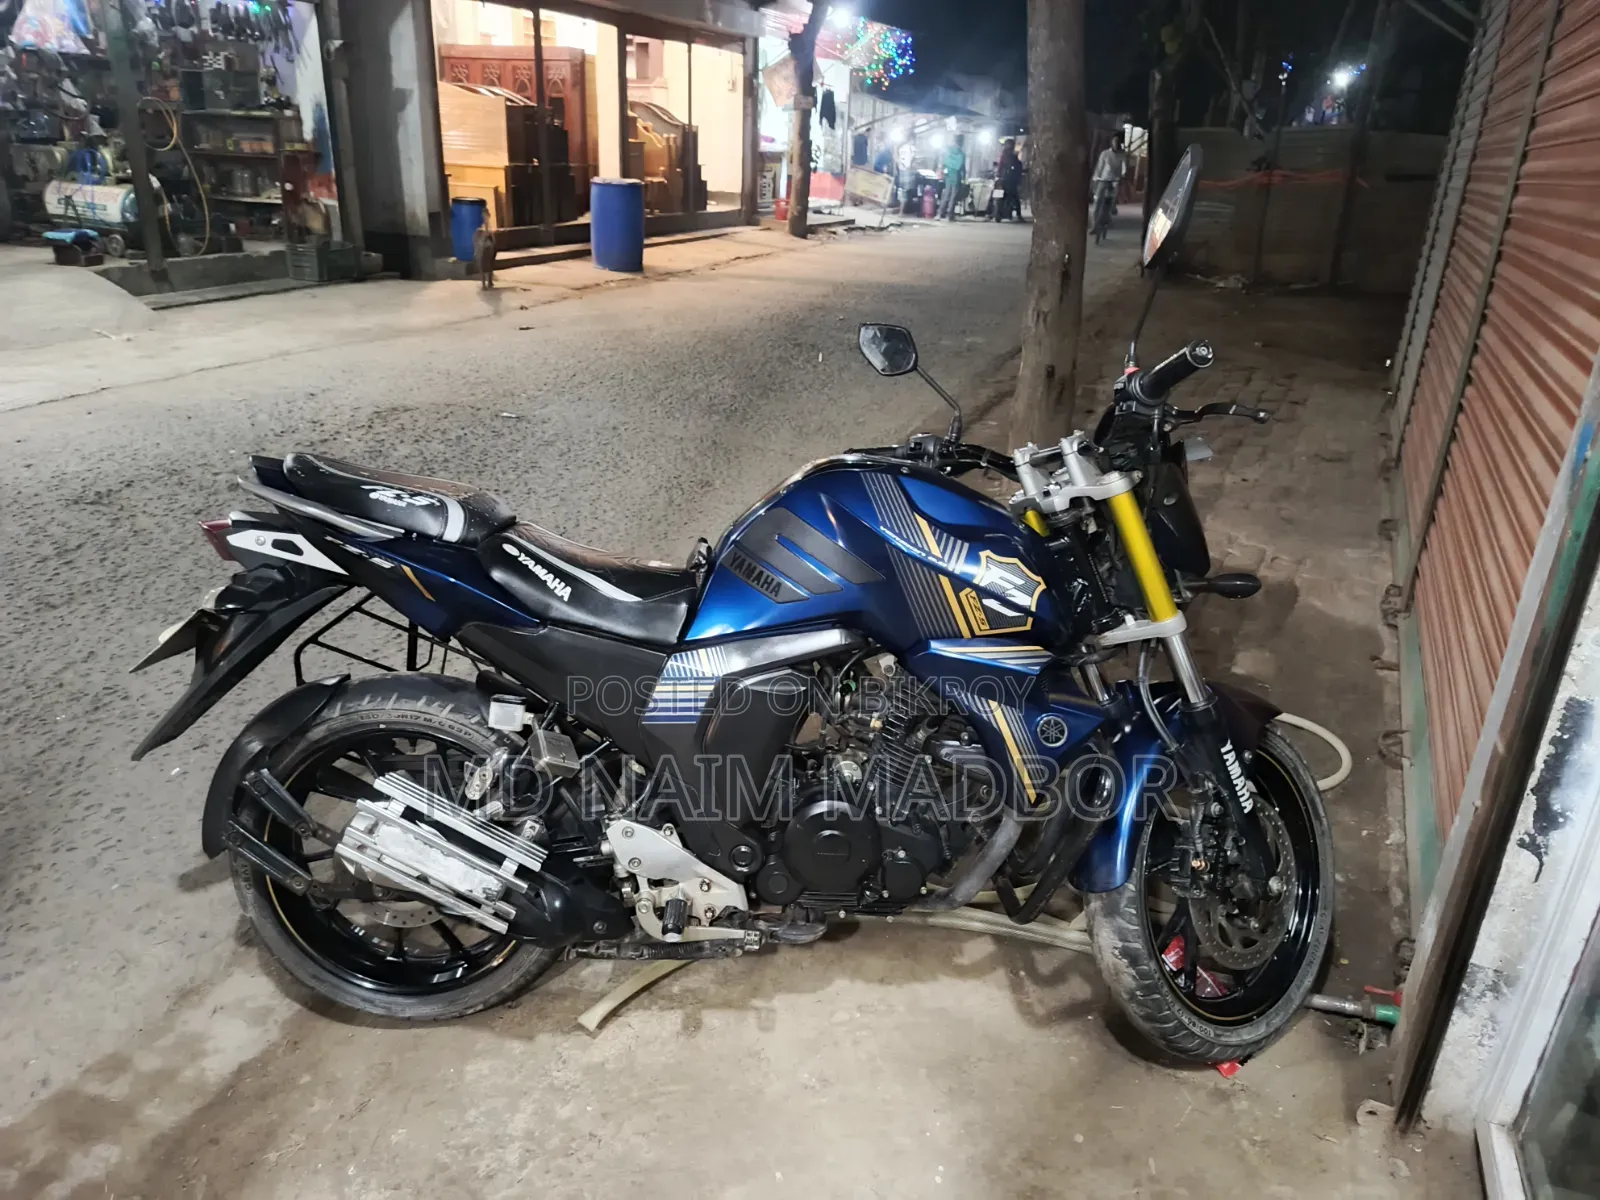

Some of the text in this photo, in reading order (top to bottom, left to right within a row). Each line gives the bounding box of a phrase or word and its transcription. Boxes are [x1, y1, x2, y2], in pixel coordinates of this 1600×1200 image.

[518, 552, 572, 602] YAMAHA
[729, 552, 782, 598] YAMAHA
[1220, 737, 1254, 814] YAMAHA
